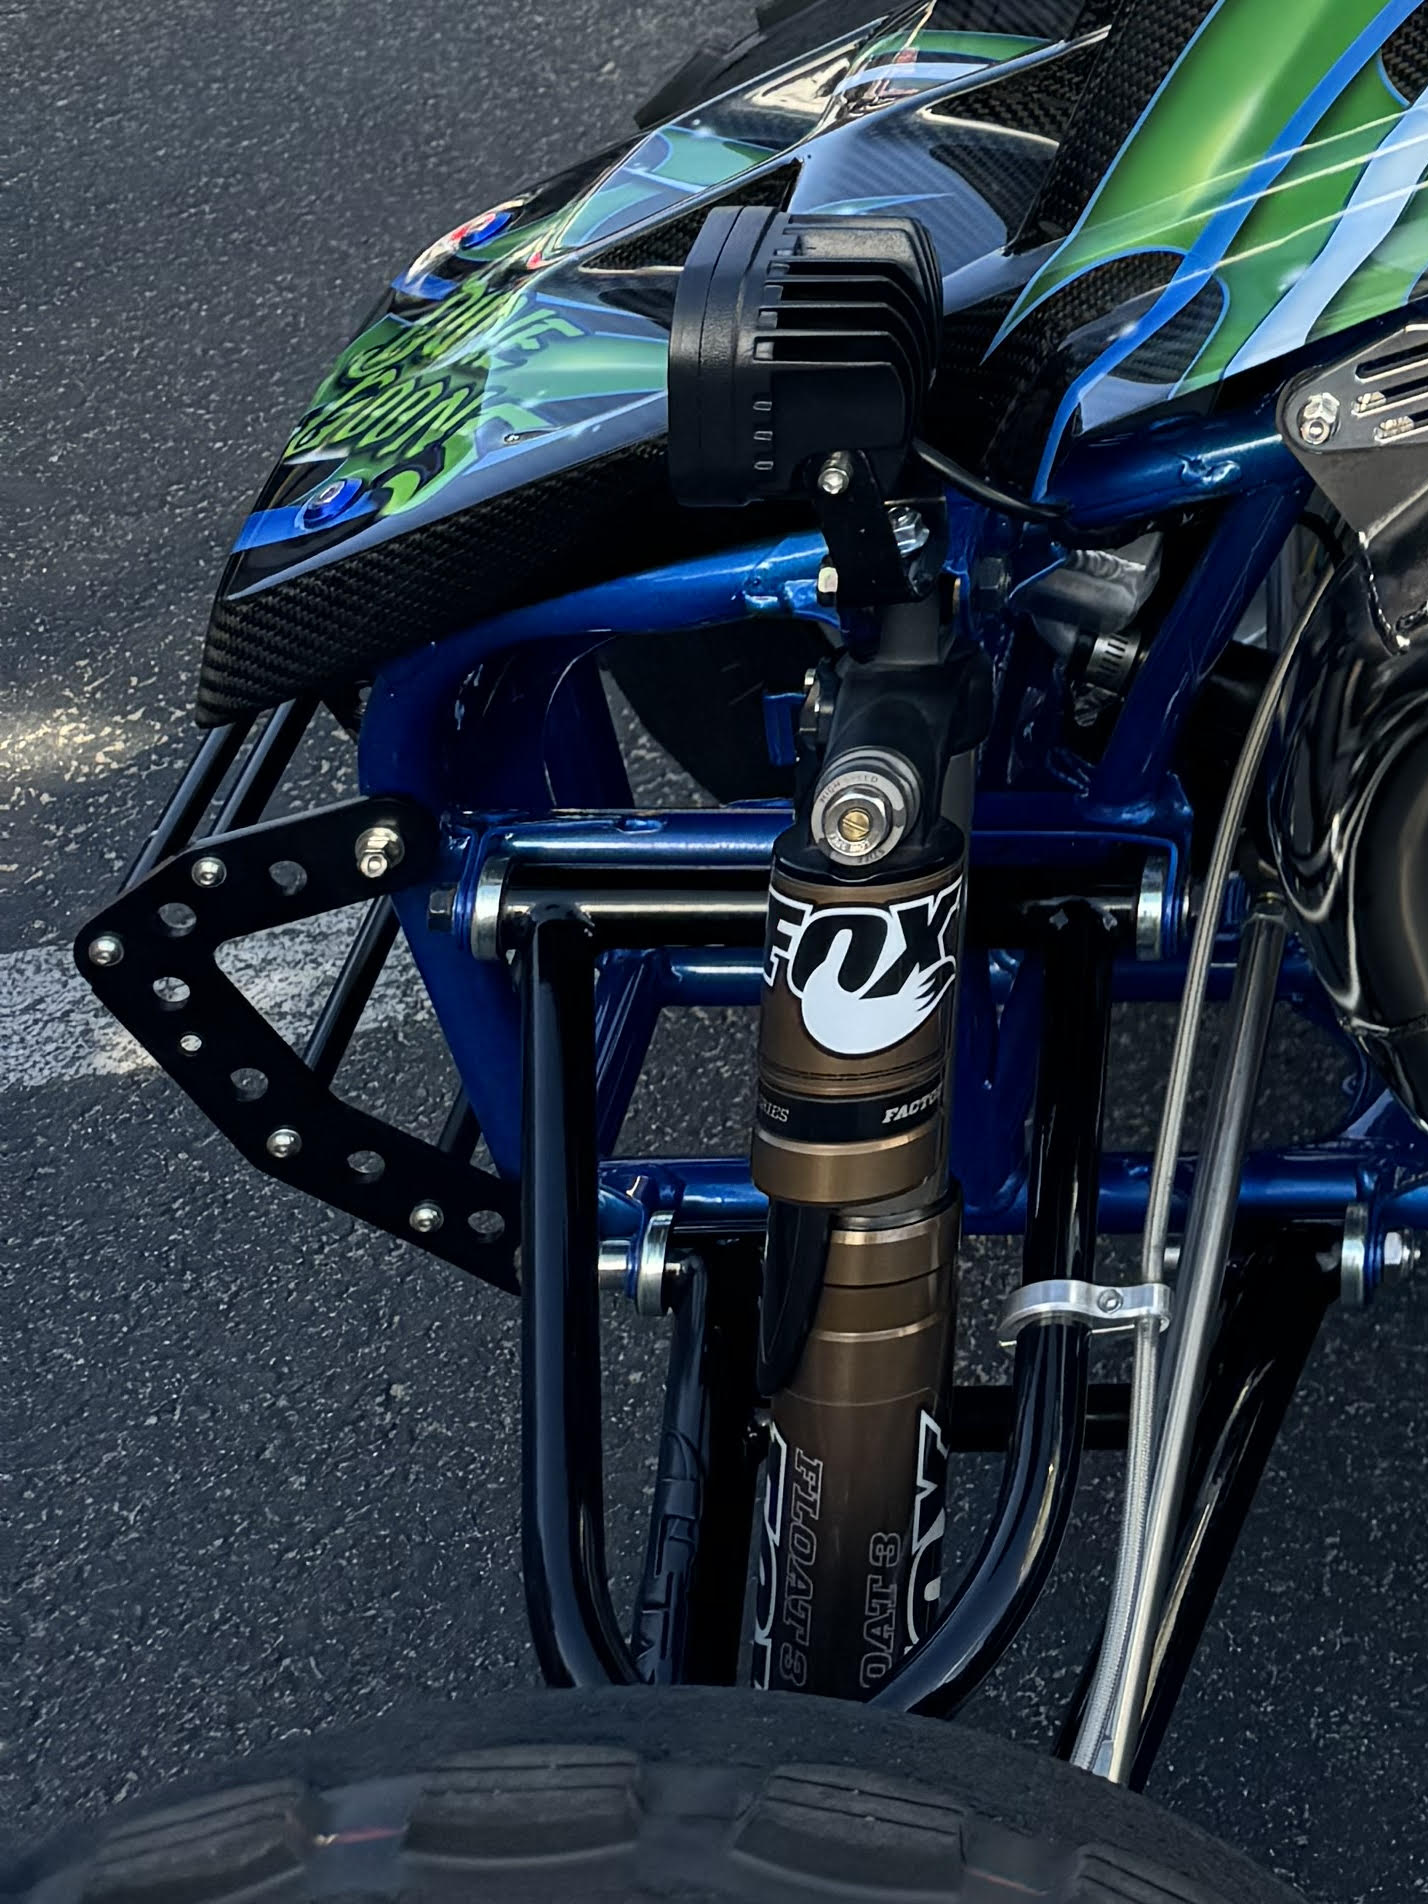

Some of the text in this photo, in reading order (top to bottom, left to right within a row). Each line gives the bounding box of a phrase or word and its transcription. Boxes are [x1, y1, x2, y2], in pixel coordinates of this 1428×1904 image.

[761, 885, 963, 998] FOX
[783, 1447, 824, 1647] FLOAT
[860, 1574, 899, 1689] OAT
